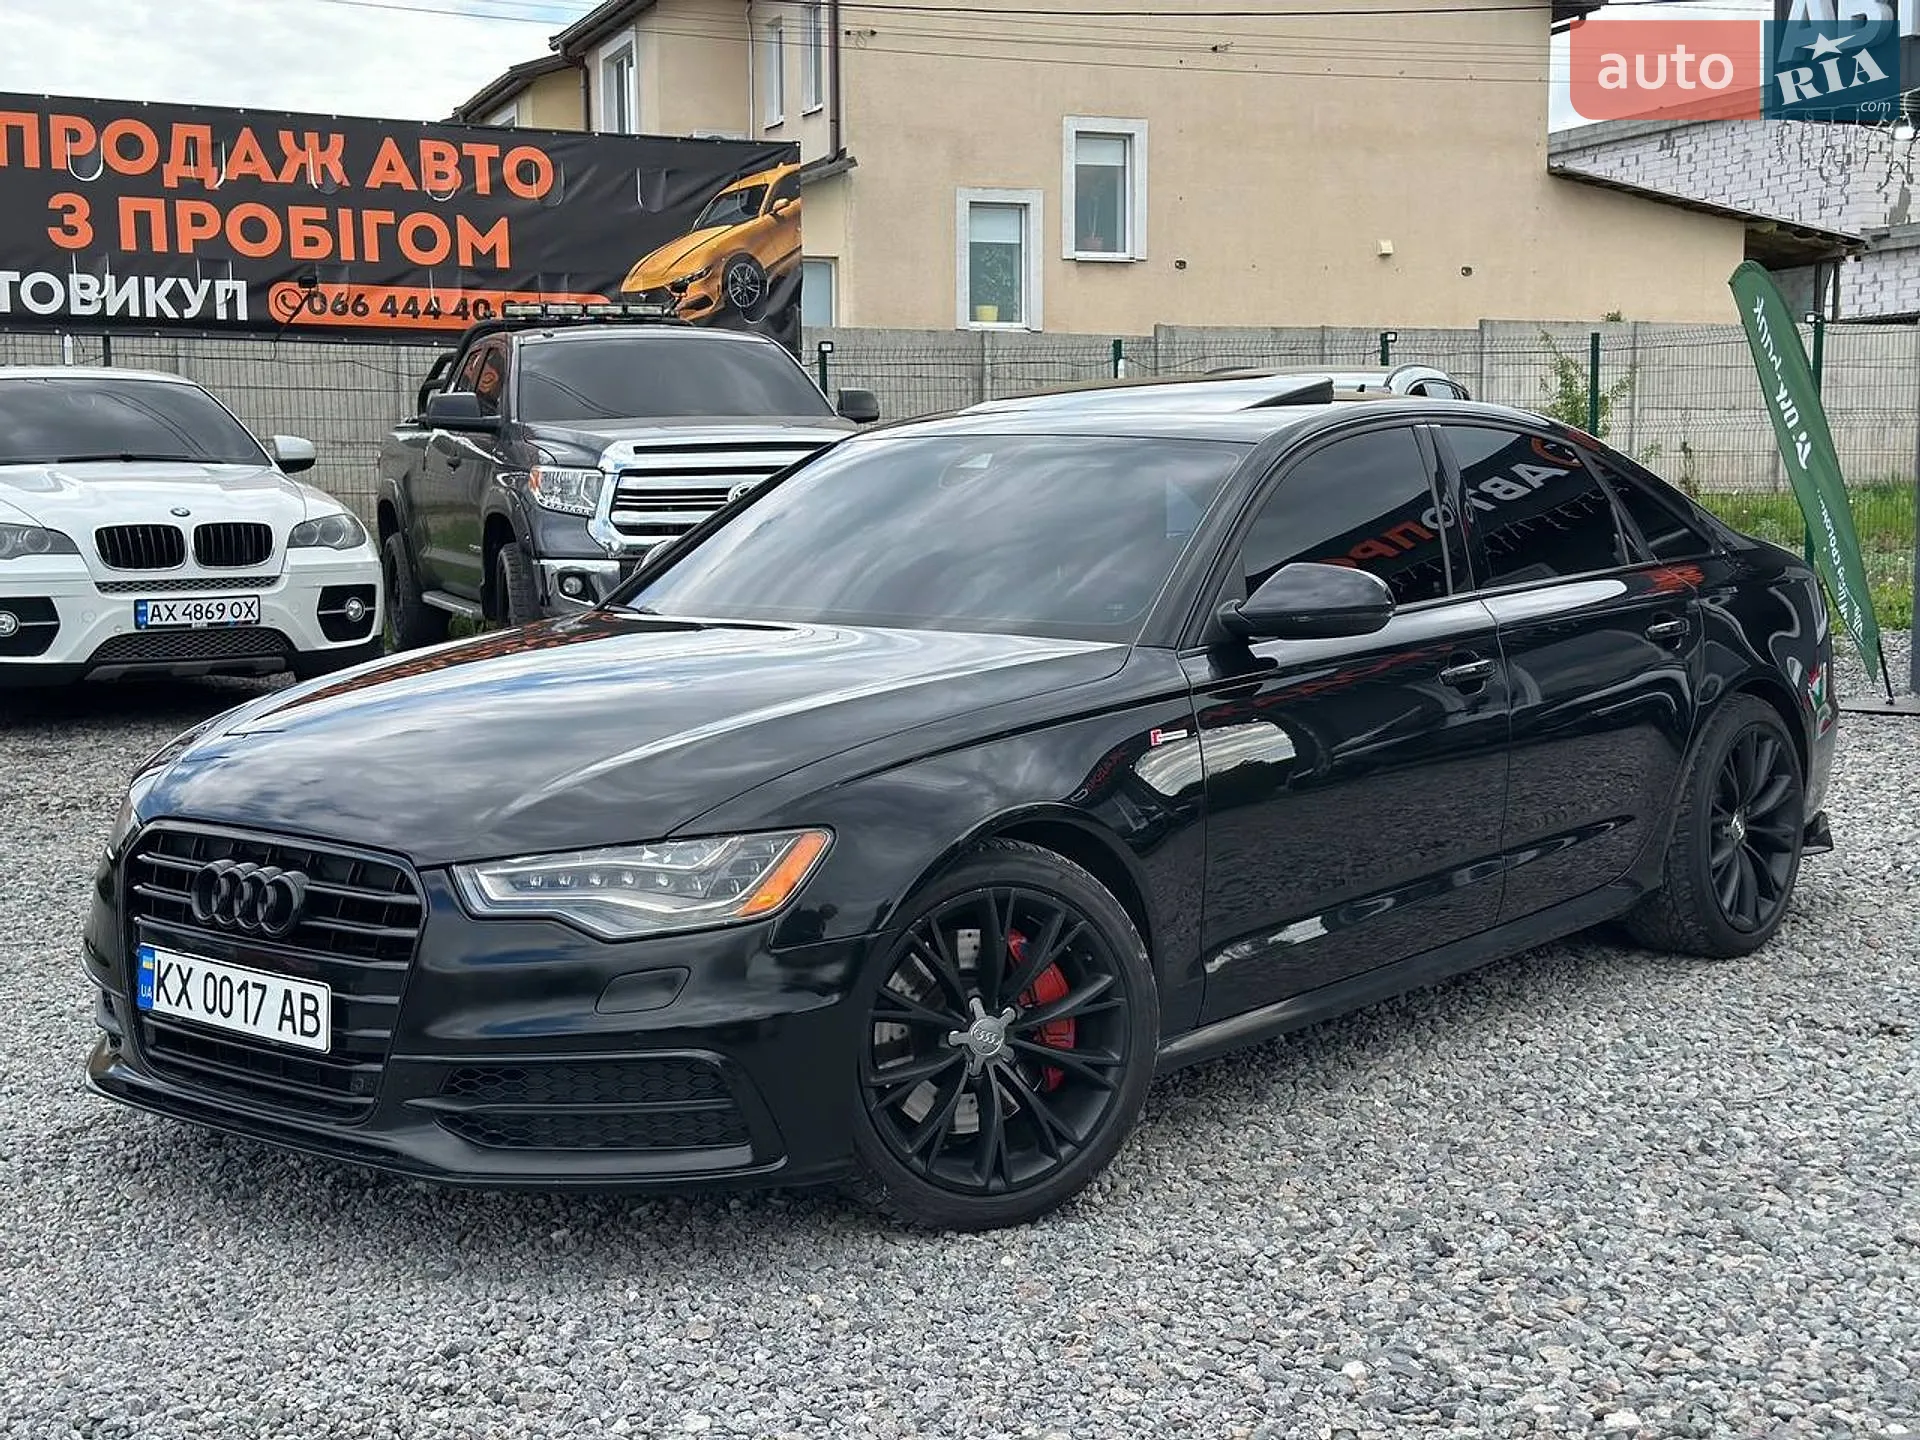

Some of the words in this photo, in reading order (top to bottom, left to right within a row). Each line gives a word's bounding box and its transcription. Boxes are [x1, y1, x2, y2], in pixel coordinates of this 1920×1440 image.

[0, 111, 350, 190] ПРОДАЖ
[365, 136, 555, 199] АВТО
[118, 196, 511, 269] ПРОБІГОМ
[307, 291, 370, 317] 066
[380, 295, 442, 319] 444
[149, 603, 177, 622] AX
[181, 602, 226, 621] 4869
[230, 599, 256, 619] OX
[155, 959, 194, 1011] KX
[203, 971, 268, 1027] 0017
[277, 987, 322, 1038] AB
